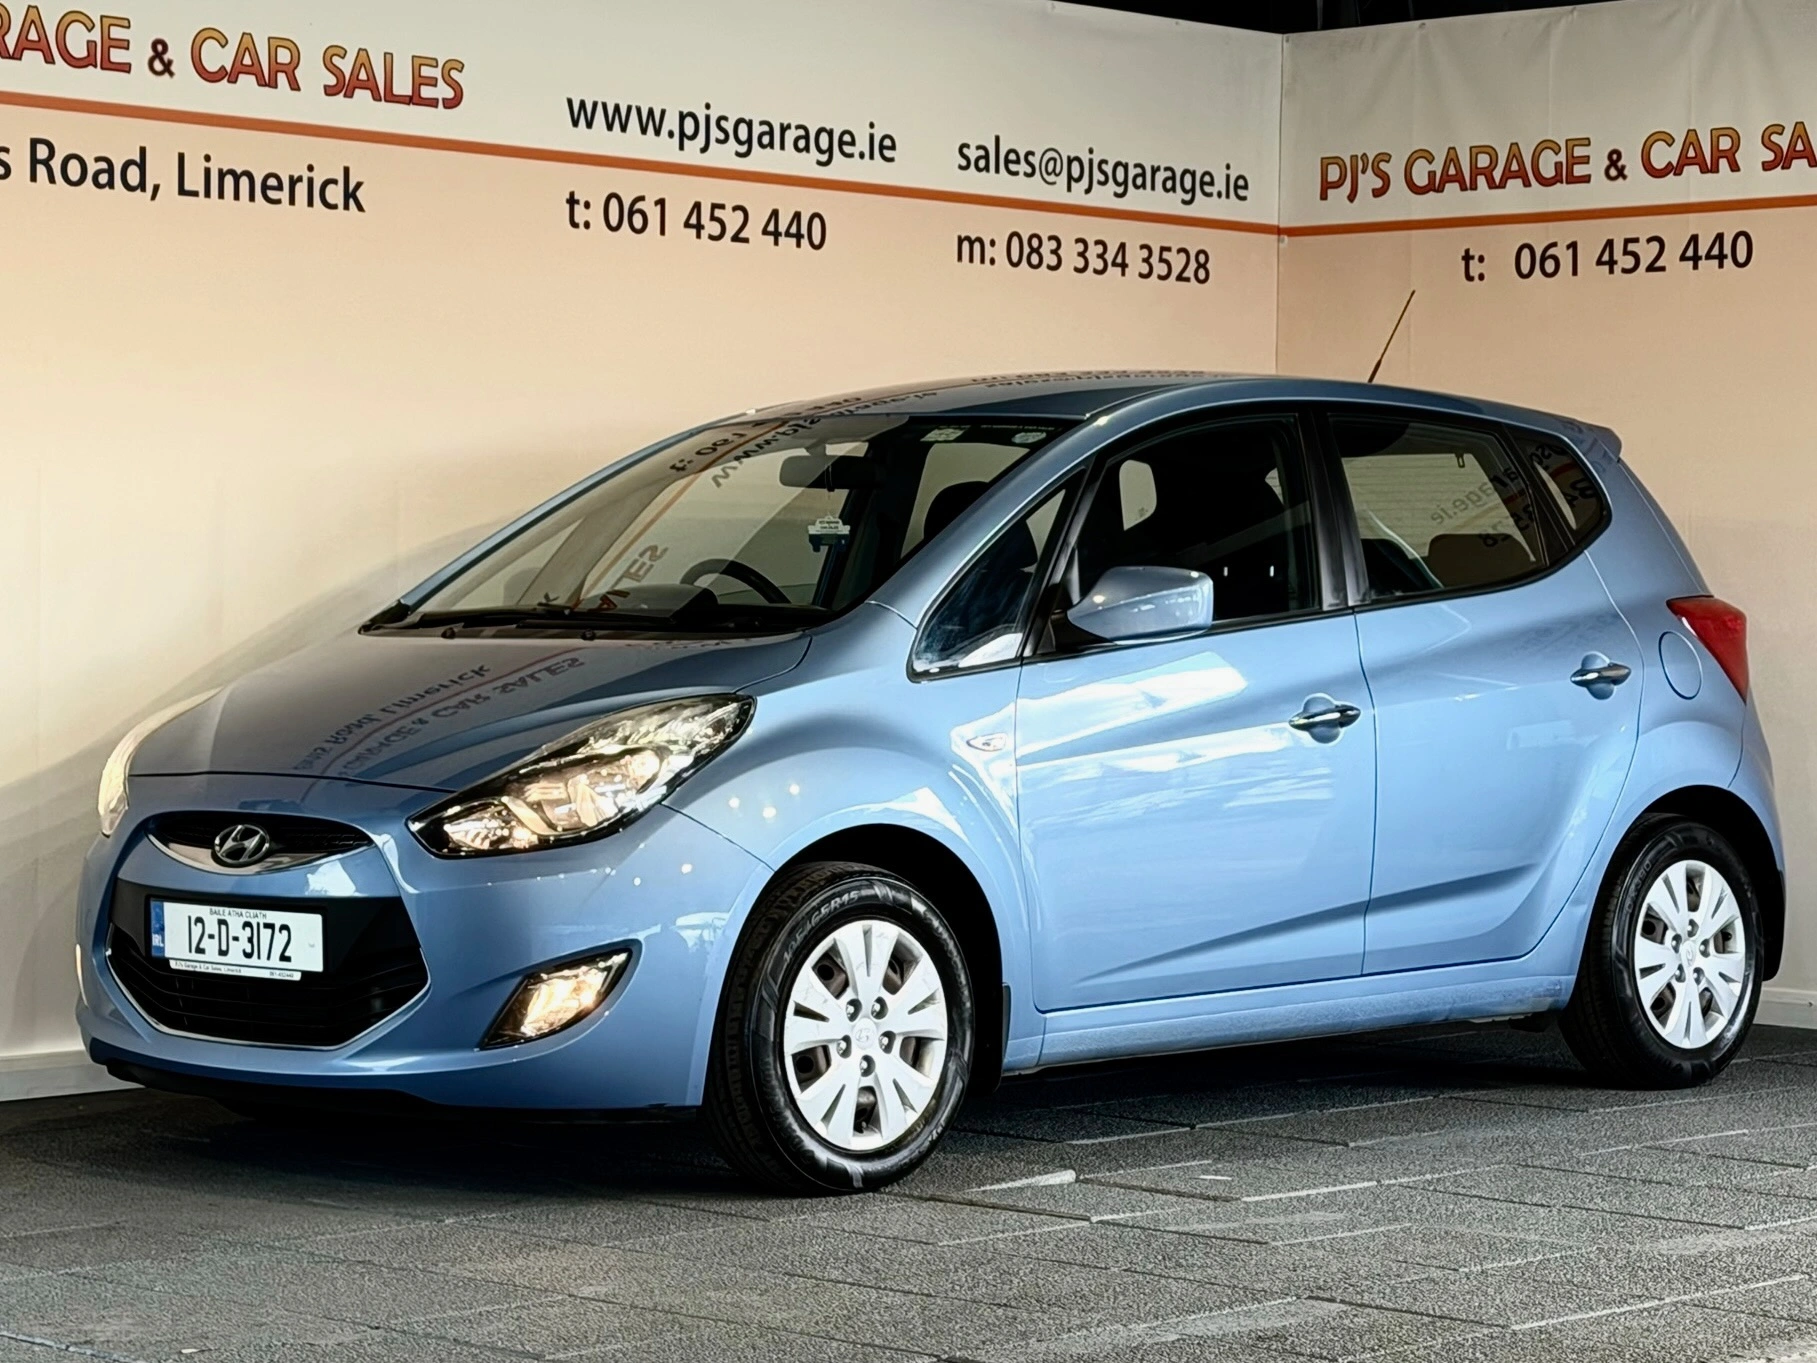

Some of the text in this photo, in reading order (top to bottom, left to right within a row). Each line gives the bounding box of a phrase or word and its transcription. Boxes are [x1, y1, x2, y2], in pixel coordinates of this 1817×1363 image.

[147, 38, 175, 78] &
[190, 26, 302, 92] CAR
[322, 44, 466, 110] SALES
[566, 96, 898, 167] www.pjsgarage.ie
[29, 137, 161, 202] Road,
[177, 151, 367, 213] Limerick
[957, 134, 1250, 206] sales@pjsgarage.ie
[1319, 151, 1393, 204] PJ'S
[1403, 136, 1592, 196] GARAGE
[1603, 148, 1629, 182] &
[1640, 126, 1742, 180] CAR
[565, 190, 828, 252] t: 061 452 440
[956, 230, 1212, 285] m: 083 334 3528
[1460, 230, 1755, 282] t: 061 452 440
[187, 915, 292, 963] 12-D-3172
[209, 908, 226, 917] BAILE
[245, 910, 267, 920] CLIATH
